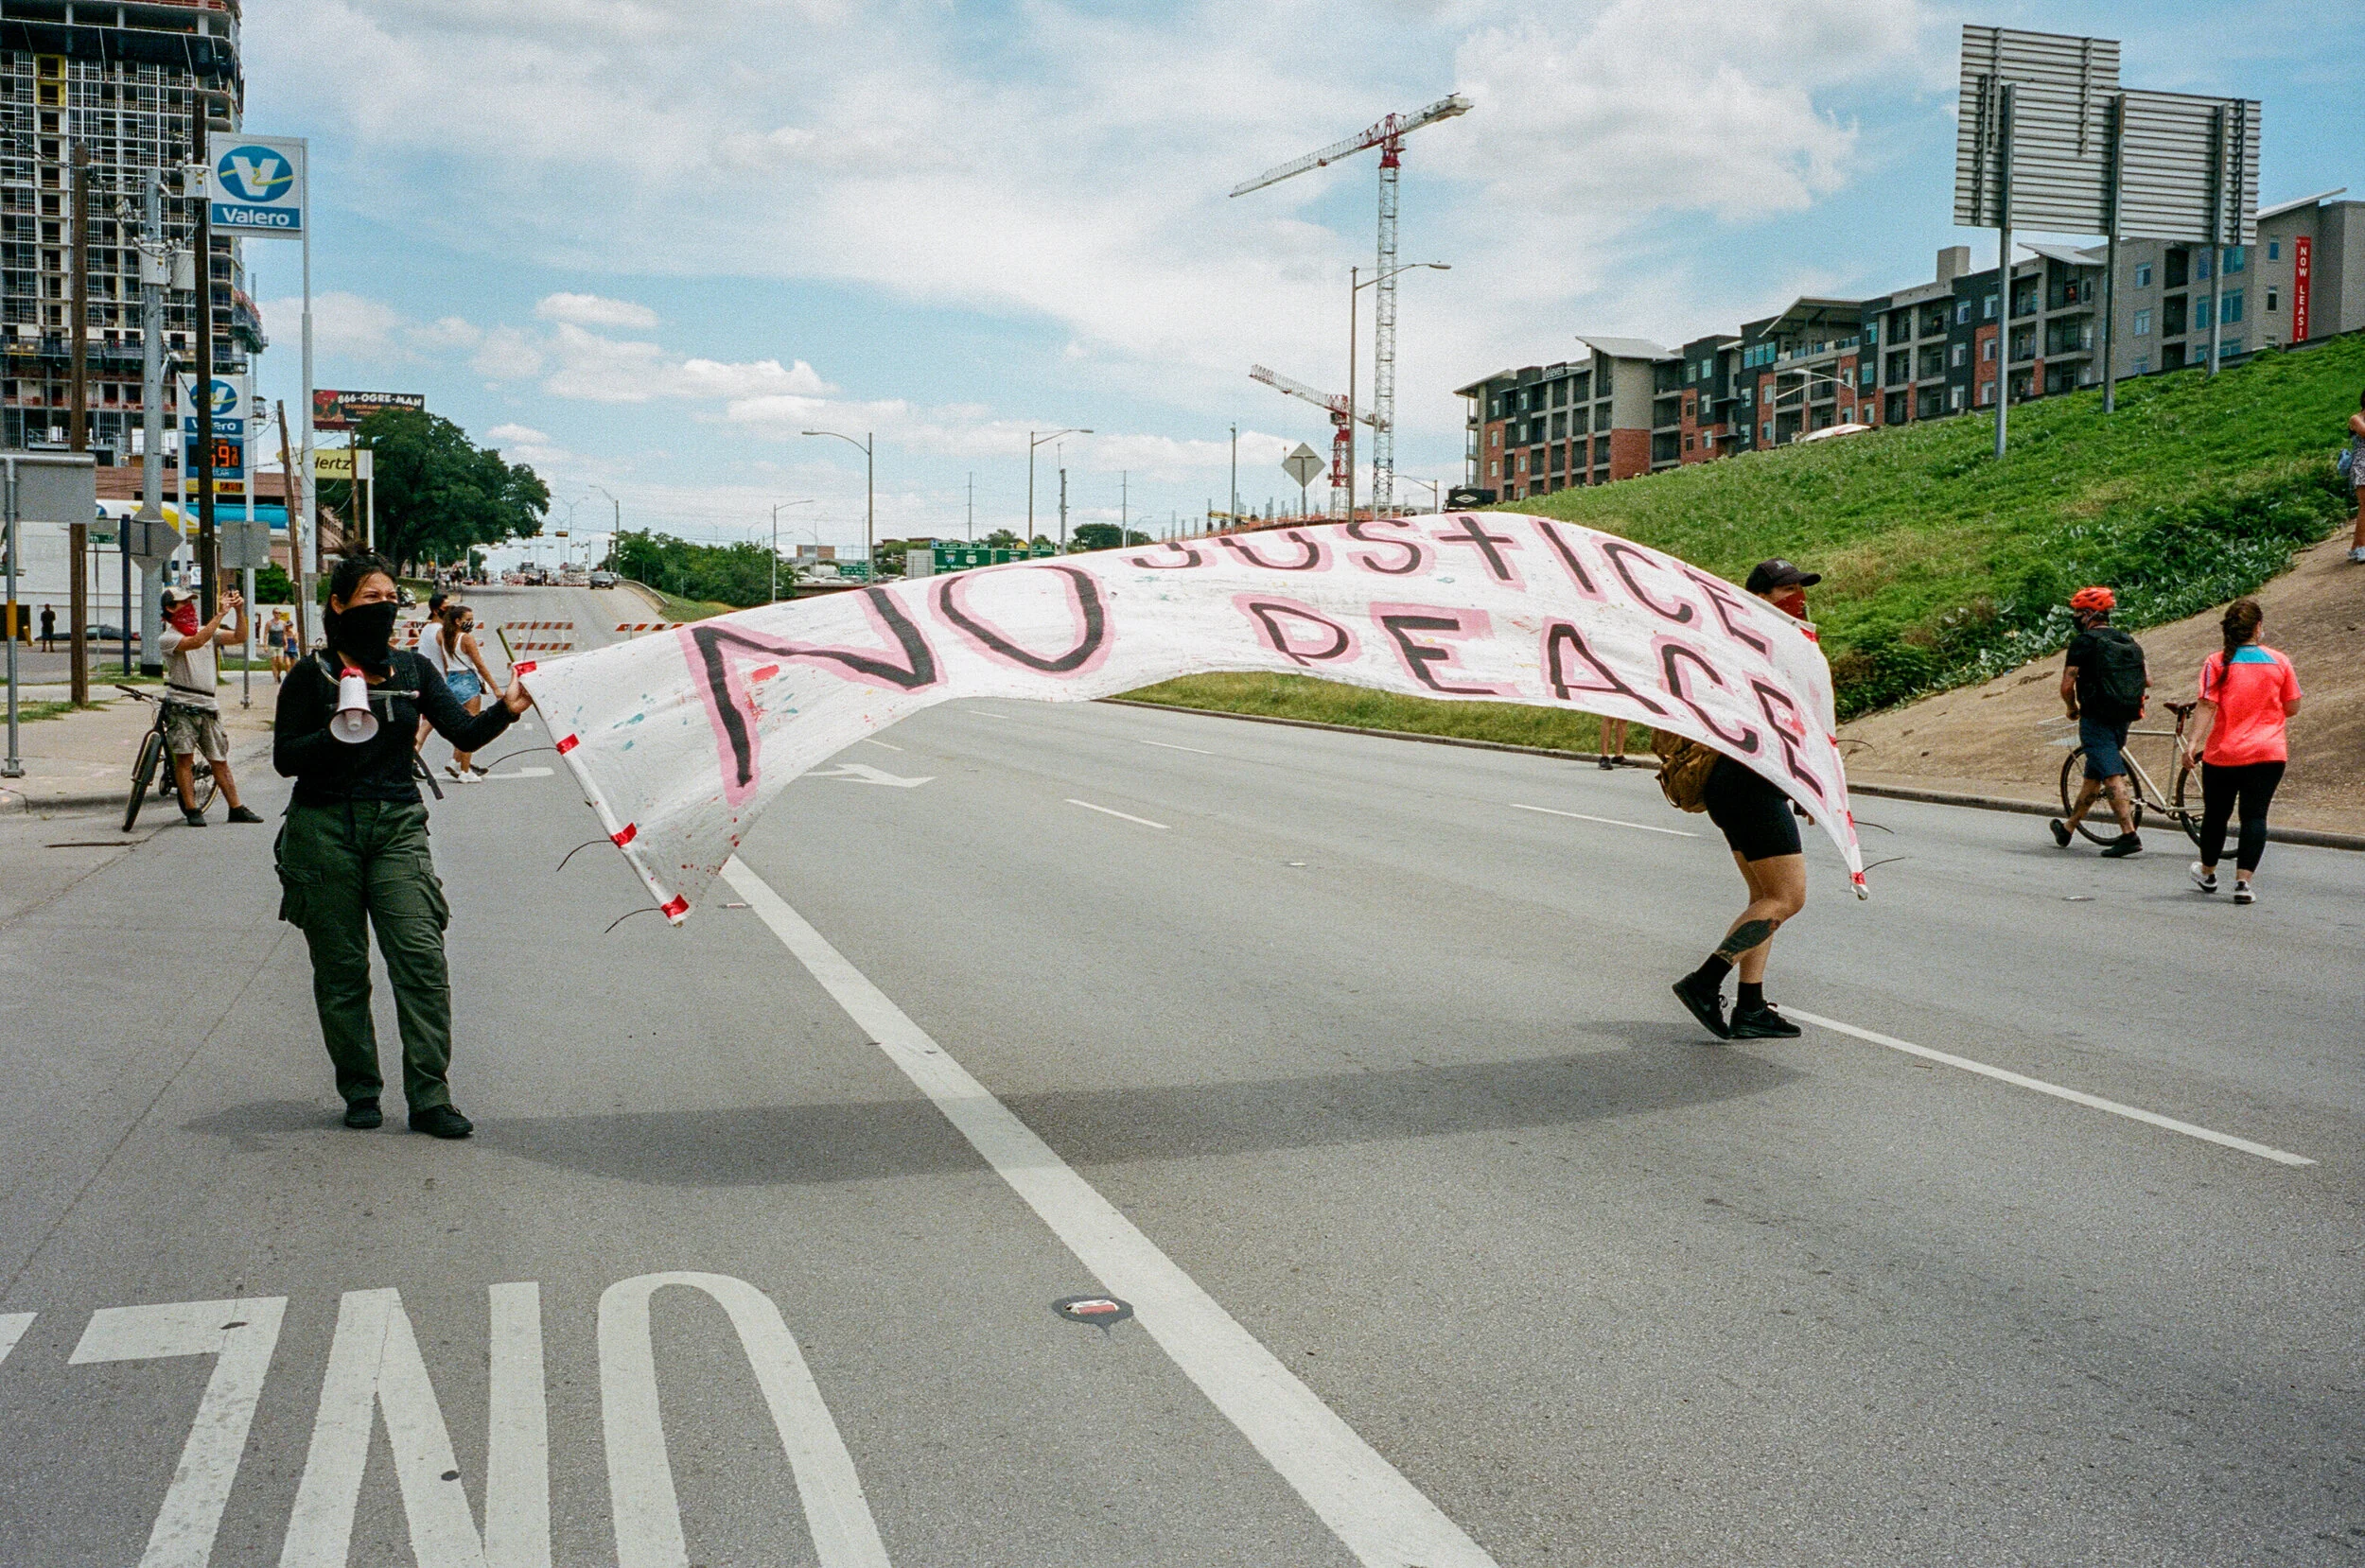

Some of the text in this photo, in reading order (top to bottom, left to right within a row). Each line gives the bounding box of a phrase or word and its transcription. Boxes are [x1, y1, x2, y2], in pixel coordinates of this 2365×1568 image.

[222, 207, 290, 226] Valero
[2297, 246, 2308, 277] NOW
[685, 564, 1110, 796] NO
[1247, 601, 1825, 799] PEACE
